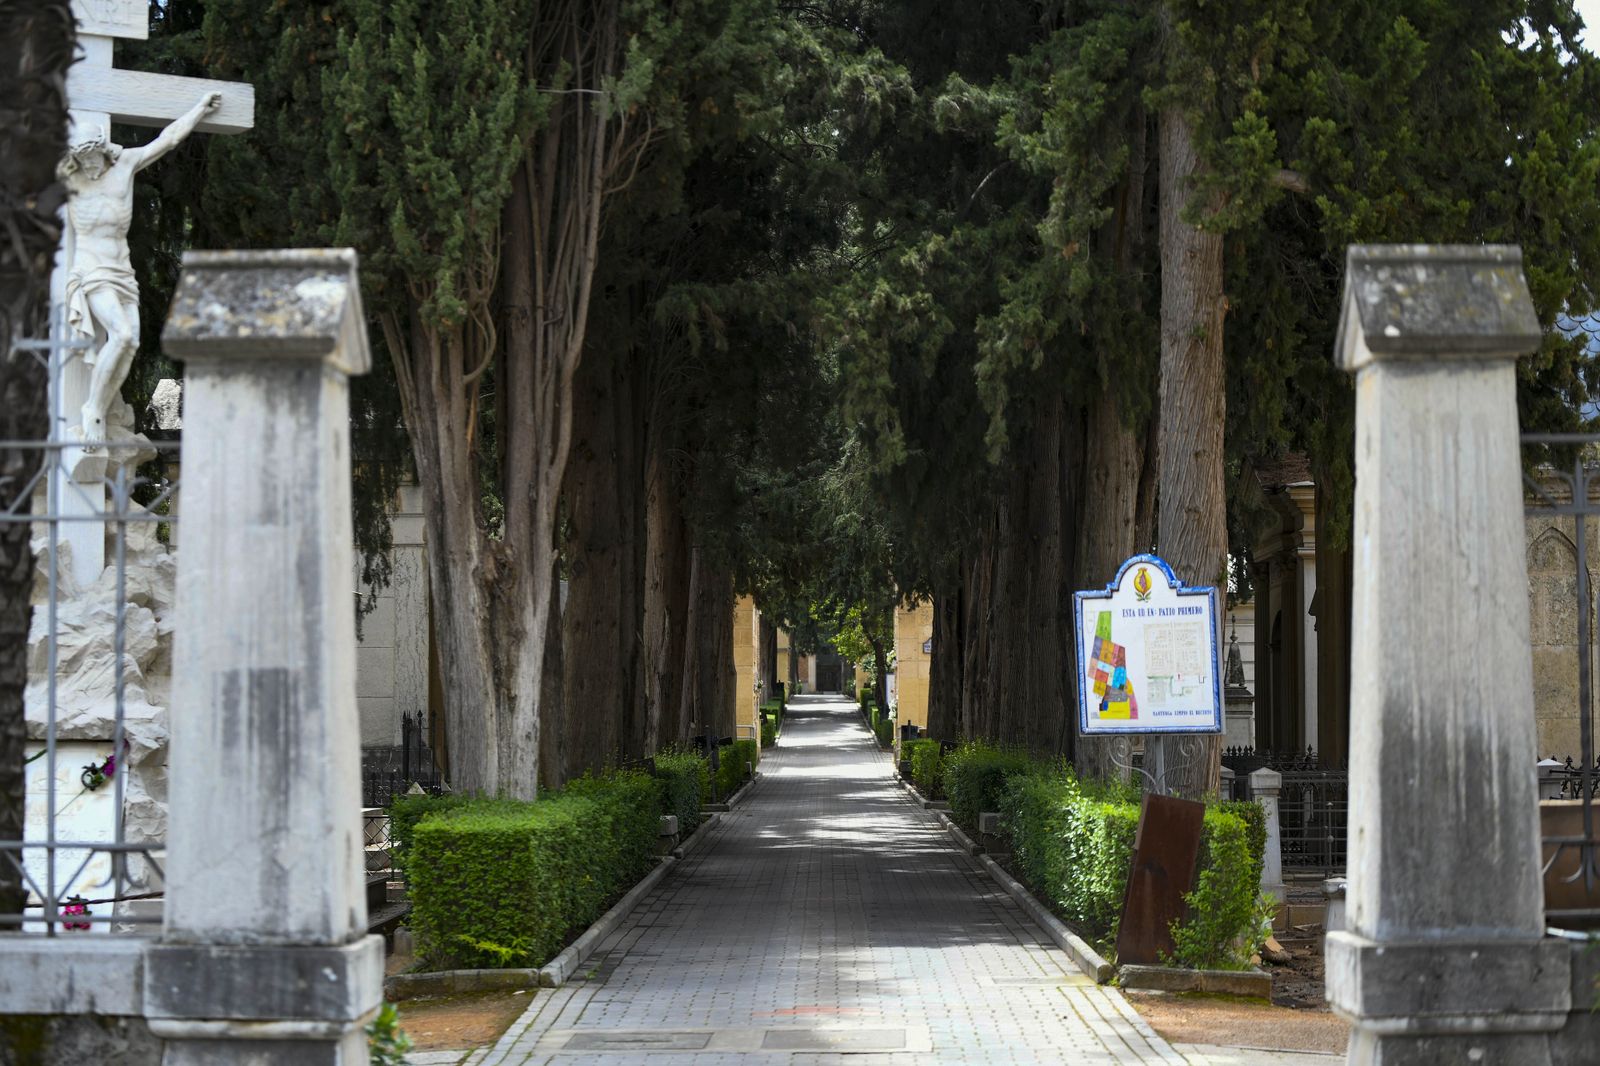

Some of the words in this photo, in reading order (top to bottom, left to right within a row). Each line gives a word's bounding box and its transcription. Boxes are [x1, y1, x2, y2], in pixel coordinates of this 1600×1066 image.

[1122, 608, 1136, 618] ESTA
[1158, 607, 1176, 616] PATIO
[1178, 606, 1203, 615] PRIMERO
